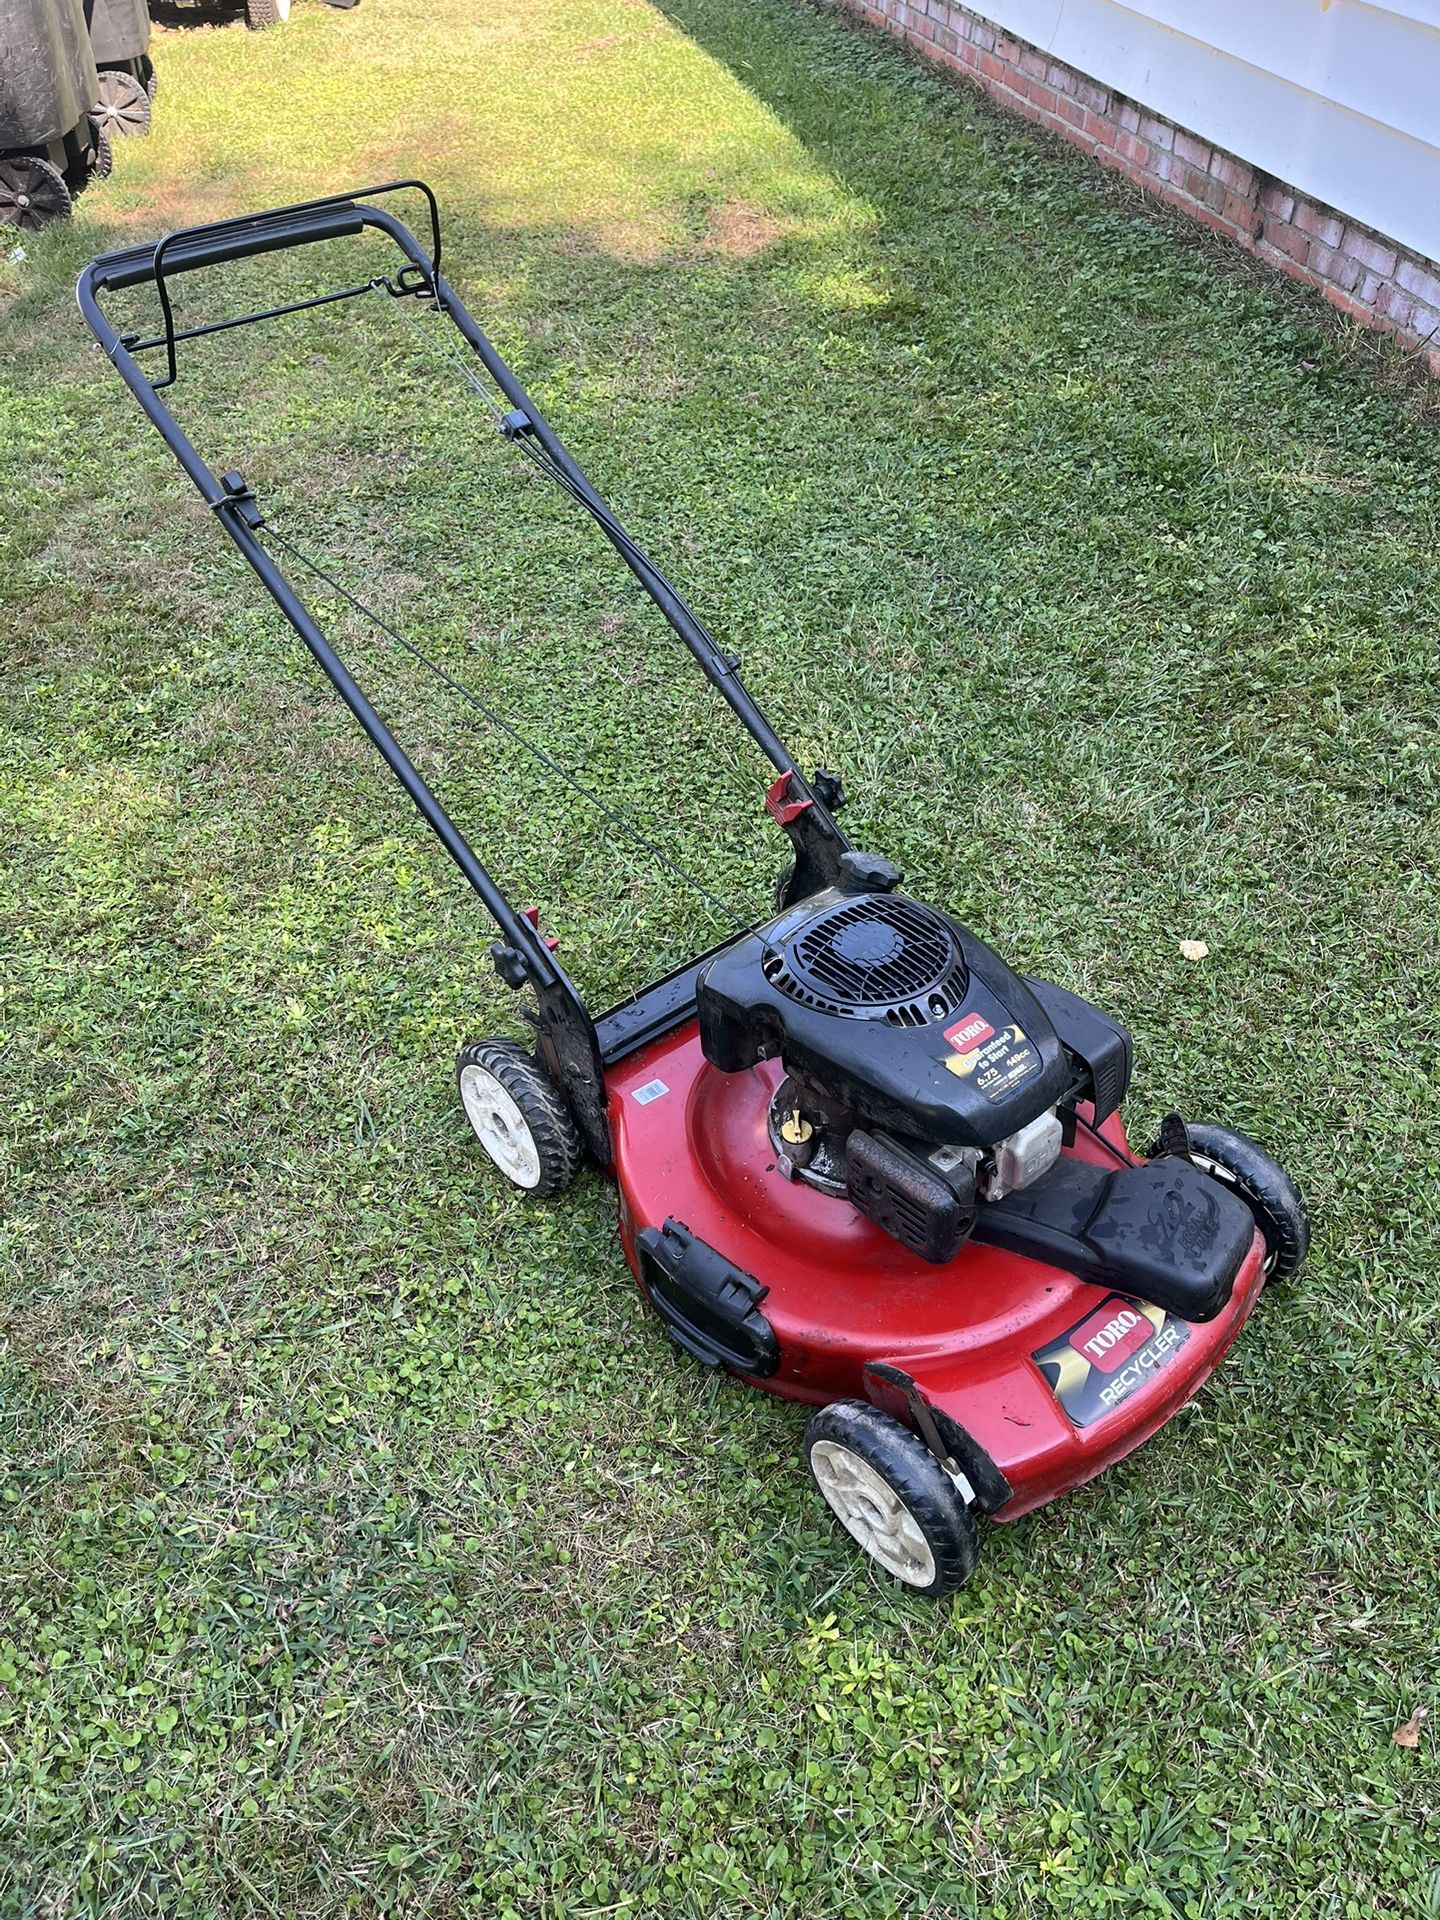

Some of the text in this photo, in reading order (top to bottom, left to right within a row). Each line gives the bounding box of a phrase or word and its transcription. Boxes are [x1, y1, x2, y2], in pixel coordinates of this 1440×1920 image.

[963, 1031, 1011, 1067] Guaranteed
[978, 1045, 1009, 1070] to Start
[976, 1067, 998, 1086] 6.75
[1006, 1049, 1030, 1067] 149cc
[1099, 1327, 1181, 1406] RECYCLER
